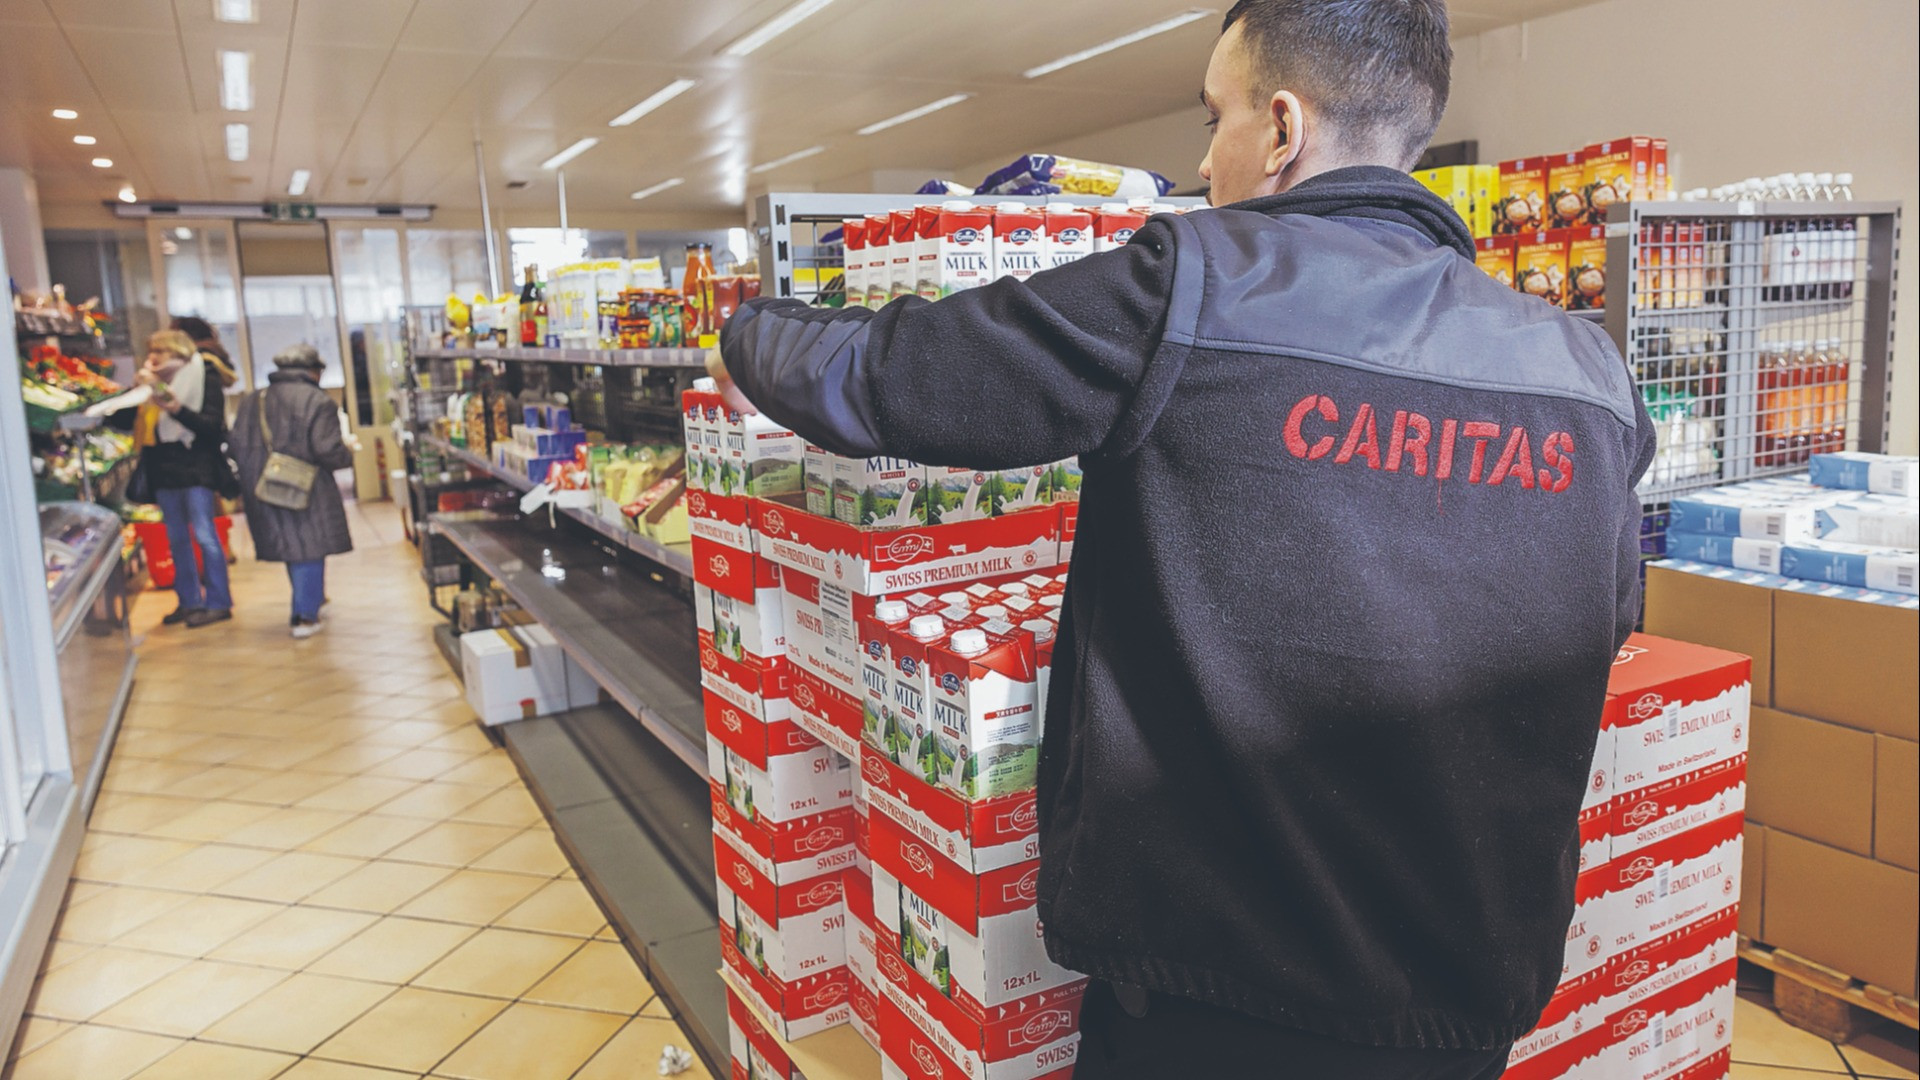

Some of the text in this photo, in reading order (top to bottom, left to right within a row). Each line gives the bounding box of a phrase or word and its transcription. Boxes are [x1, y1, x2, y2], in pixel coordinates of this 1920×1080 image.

[946, 256, 987, 270] MILK
[1001, 256, 1041, 270] MILK
[705, 433, 721, 448] MILK
[727, 435, 745, 451] MILK
[1283, 394, 1575, 493] CARITAS
[891, 542, 920, 554] Emmi
[885, 556, 1012, 589] SWISS PREMIUM MILK
[863, 668, 887, 696] MILK
[894, 684, 923, 715] MILK
[934, 703, 967, 735] MILK
[1643, 708, 1732, 747] SWIS EMIUM MILK
[790, 796, 819, 810] 12x1L
[1014, 810, 1037, 822] Emm
[919, 821, 939, 848] MILK
[817, 851, 847, 870] SWISS
[1635, 890, 1654, 909] SWIS
[1670, 871, 1701, 895] EMIUM
[909, 891, 938, 930] MILK
[822, 913, 845, 933] SWI
[1003, 971, 1041, 990] 12x1L
[1053, 990, 1069, 999] PULL
[825, 1007, 850, 1025] SWIS
[1026, 1016, 1056, 1034] Emmi
[936, 1032, 957, 1060] MILK
[1508, 1031, 1560, 1063] EMIUM MILK
[1628, 1040, 1649, 1061] SWIS
[1665, 1019, 1693, 1043] EMIUM
[1036, 1042, 1074, 1069] SWISS
